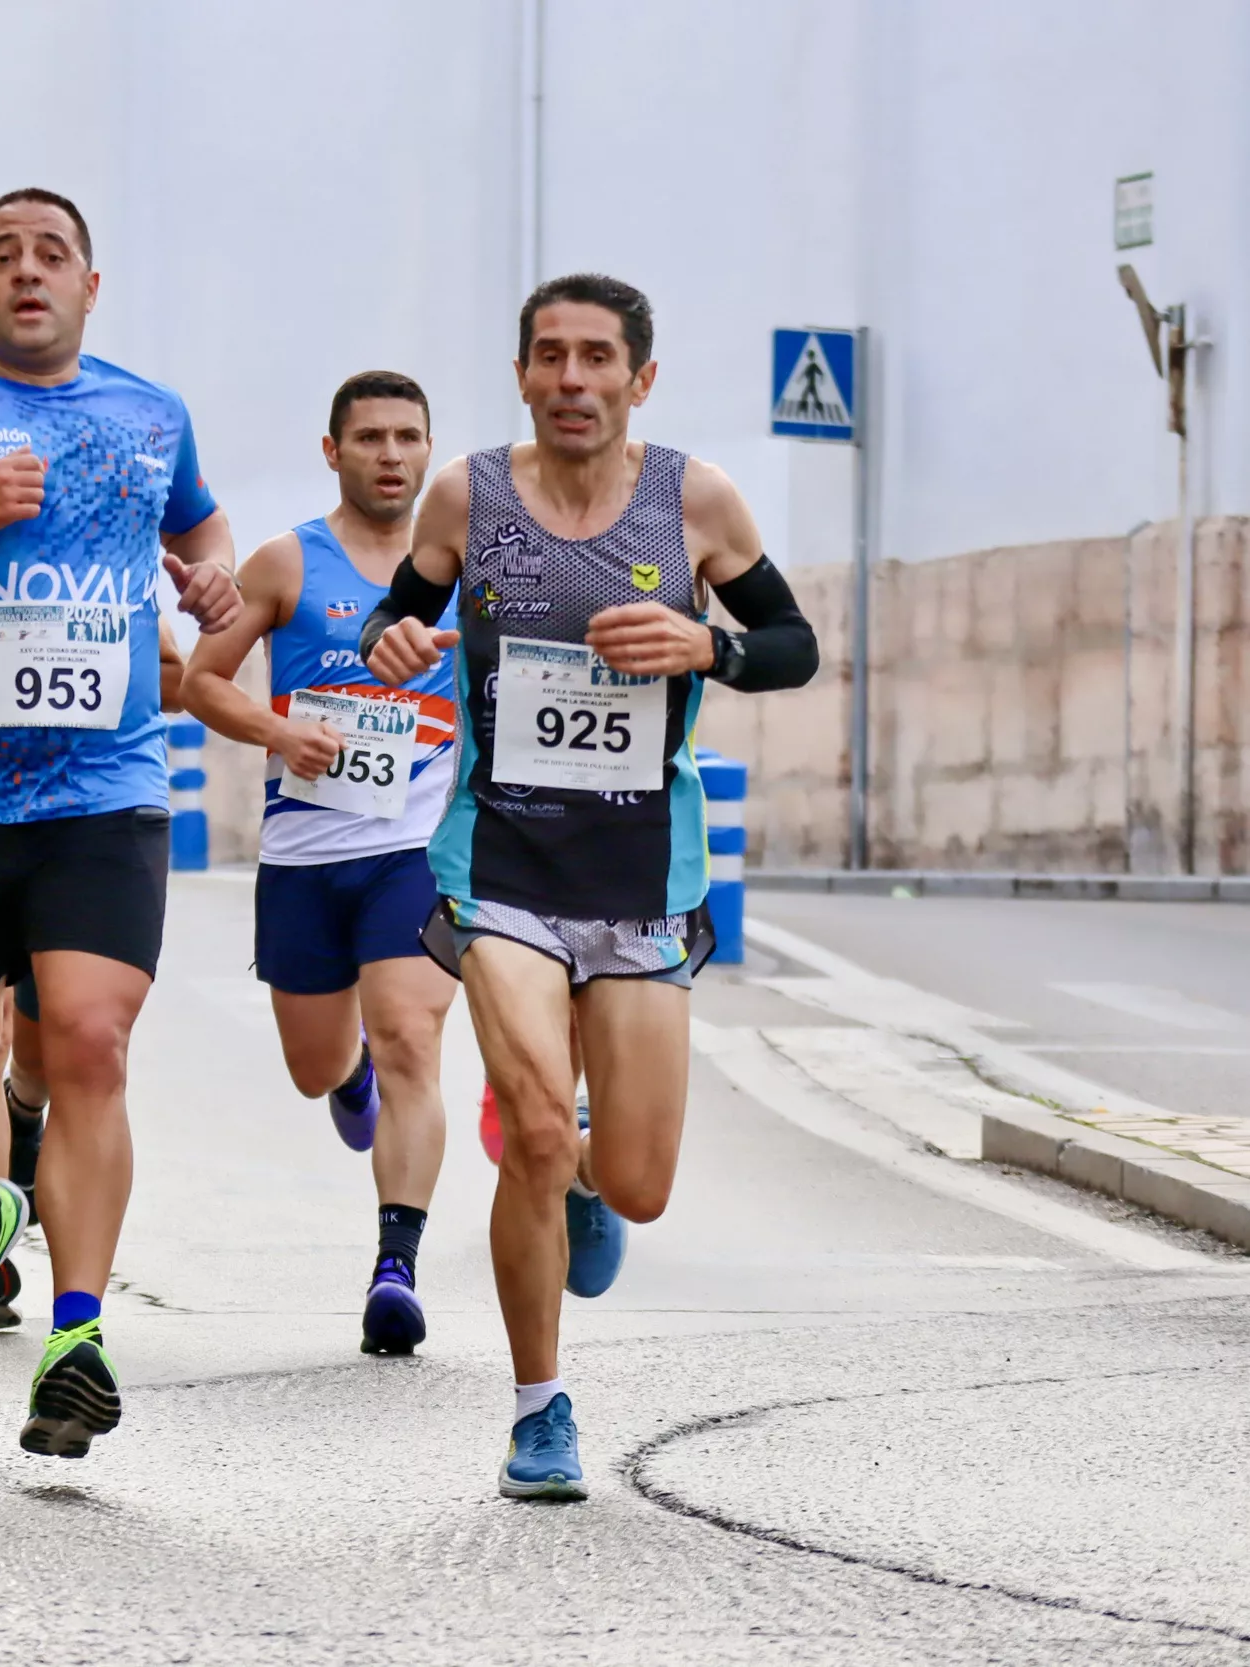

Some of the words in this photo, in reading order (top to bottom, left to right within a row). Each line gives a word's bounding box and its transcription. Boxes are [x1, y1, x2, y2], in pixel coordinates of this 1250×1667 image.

[65, 606, 104, 623] 2024
[15, 667, 102, 711] 953
[358, 701, 391, 717] 2024
[536, 707, 631, 753] 925
